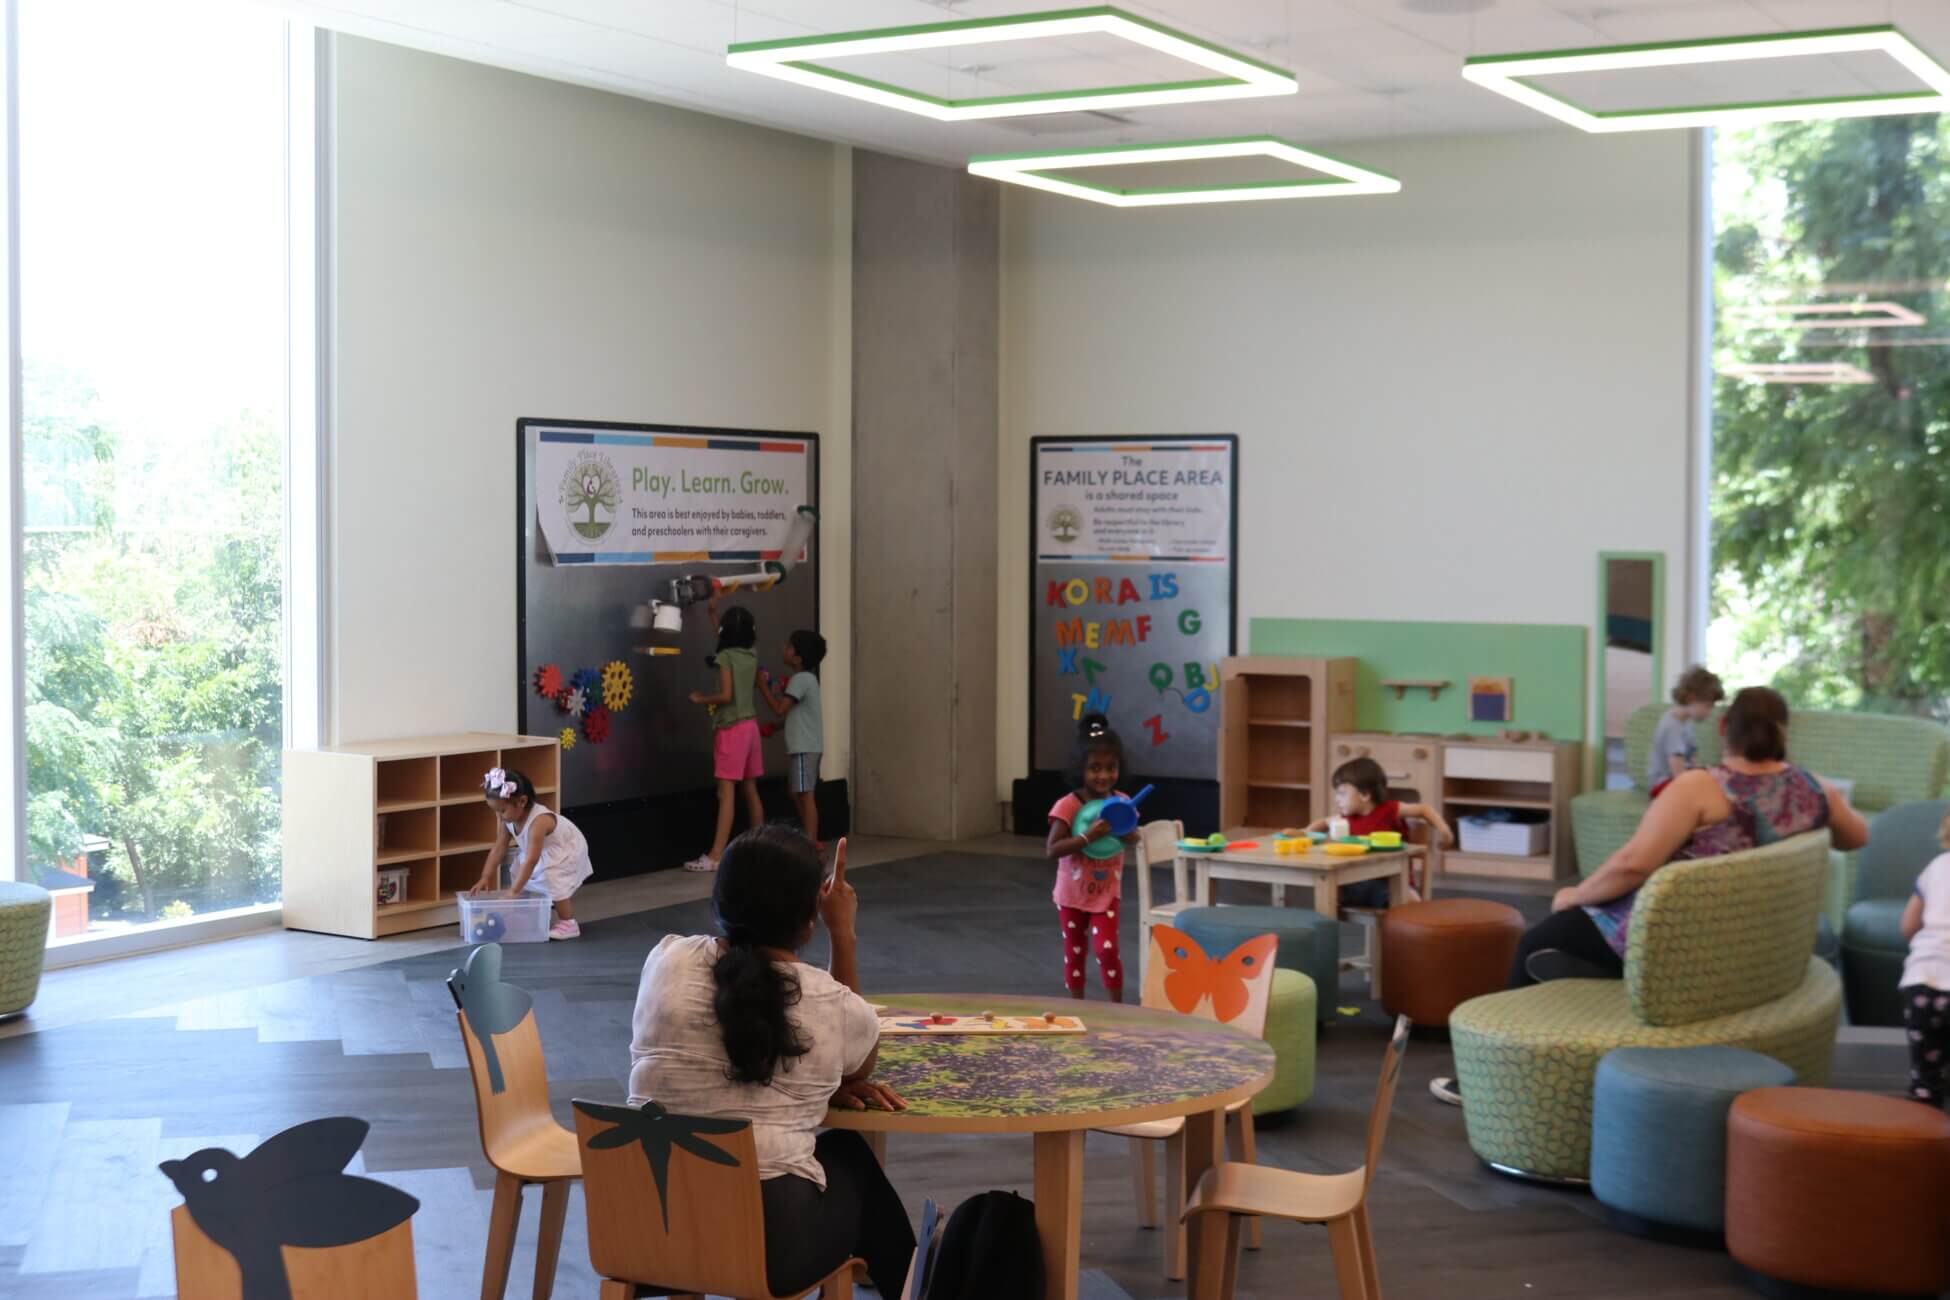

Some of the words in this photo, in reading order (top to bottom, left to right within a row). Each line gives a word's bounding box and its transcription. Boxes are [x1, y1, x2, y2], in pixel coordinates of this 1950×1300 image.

[1122, 455, 1143, 467] The
[632, 467, 676, 499] Play.
[681, 469, 736, 495] Learn.
[740, 471, 790, 496] Grow.
[1043, 470, 1109, 486] FAMILY
[1112, 470, 1169, 486] PLACE
[1173, 470, 1224, 486] AREA
[1085, 489, 1094, 501] is
[1096, 492, 1103, 501] a
[1105, 489, 1144, 501] shared
[1146, 491, 1179, 503] space
[631, 507, 648, 520] This
[648, 510, 667, 520] area
[667, 509, 674, 520] is
[674, 509, 691, 520] best
[691, 509, 721, 523] enjoyed
[721, 510, 730, 523] by
[731, 510, 756, 522] babies,
[632, 525, 647, 536] and
[648, 526, 695, 538] preschoolers
[695, 525, 713, 537] with
[712, 525, 729, 537] their
[730, 526, 768, 539] caregivers.
[1045, 576, 1140, 608] KORA
[1148, 572, 1179, 602] IS
[1177, 609, 1202, 636] G
